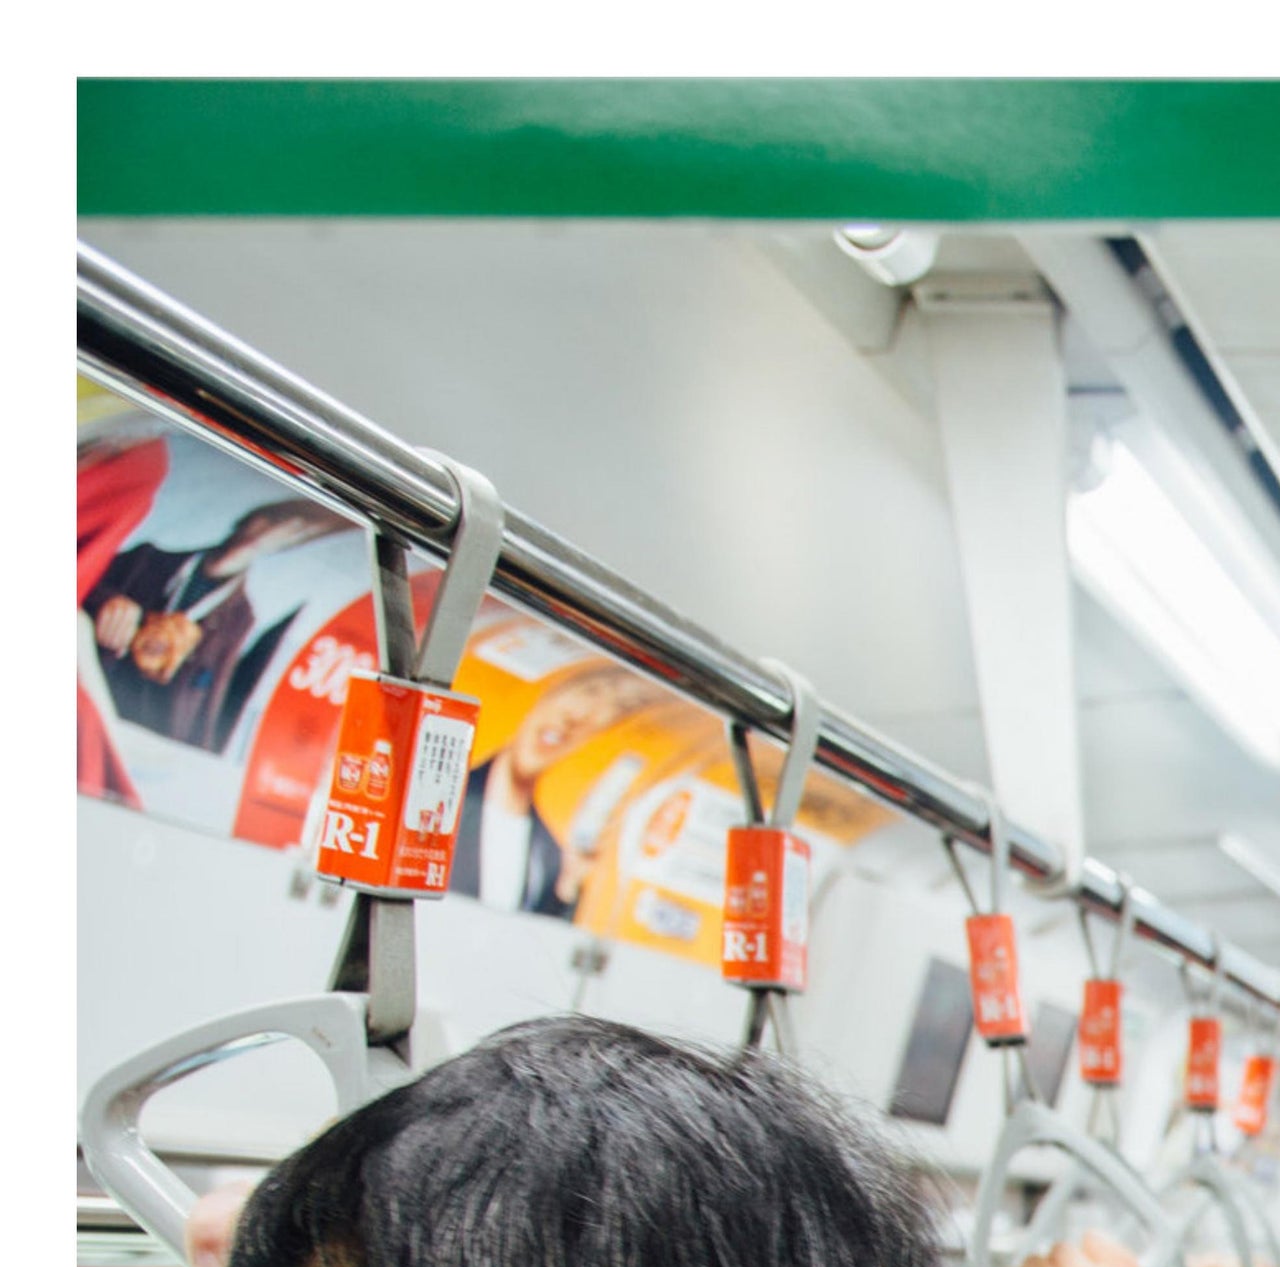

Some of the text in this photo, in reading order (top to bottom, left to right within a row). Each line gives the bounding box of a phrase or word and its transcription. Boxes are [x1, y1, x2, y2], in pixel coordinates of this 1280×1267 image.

[322, 810, 381, 860] R-1
[425, 862, 446, 887] R-1
[722, 930, 768, 963] R-1
